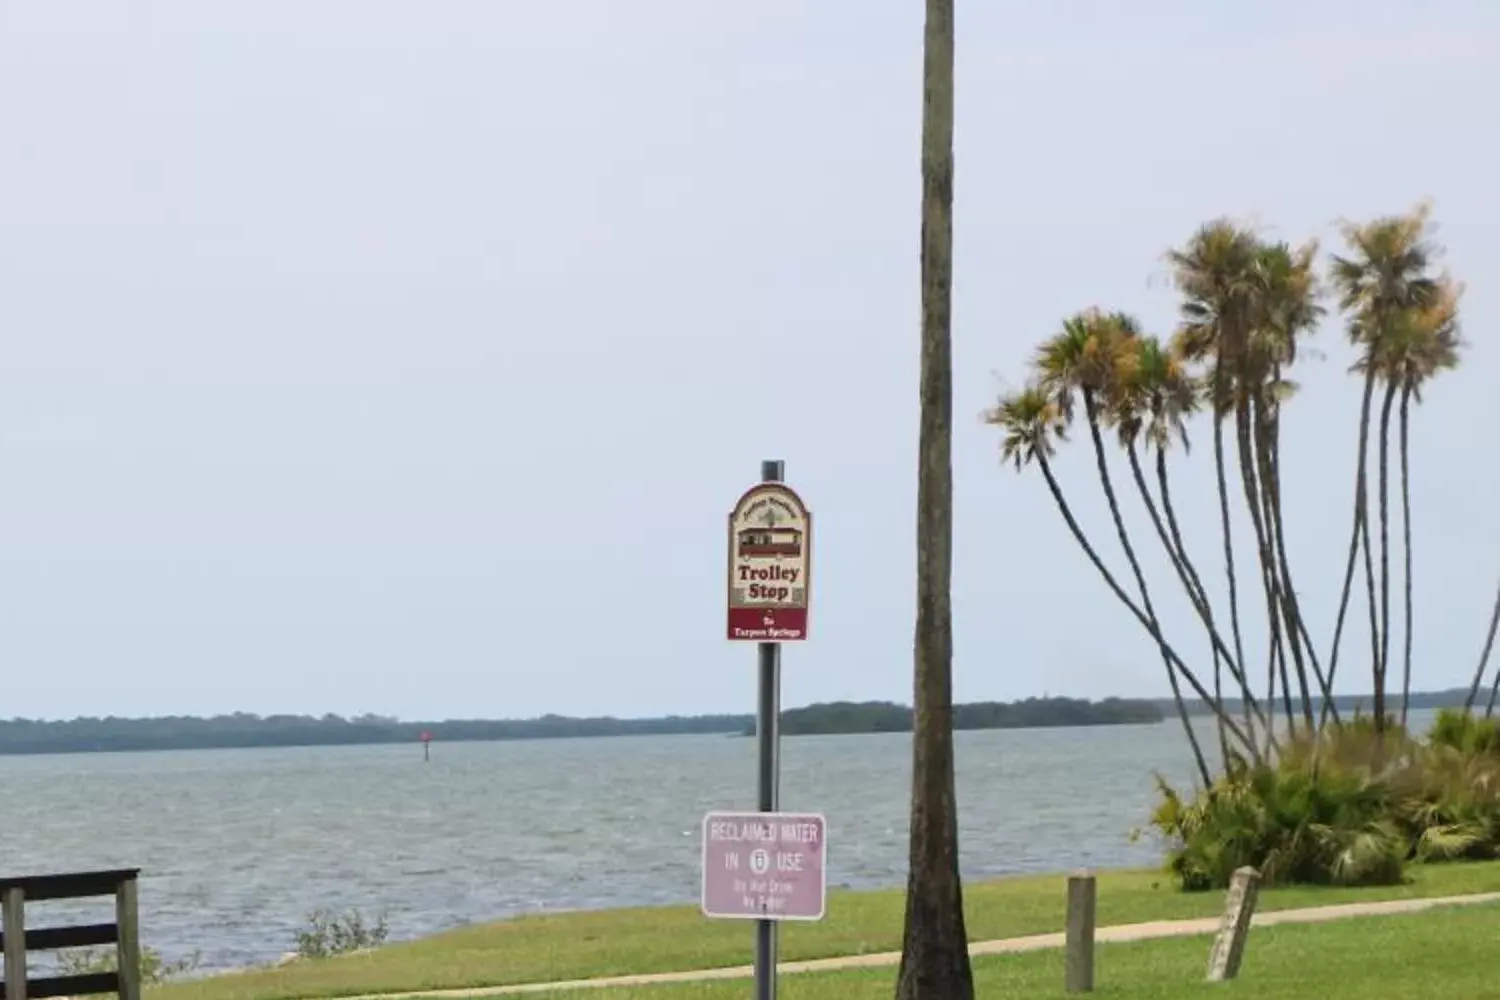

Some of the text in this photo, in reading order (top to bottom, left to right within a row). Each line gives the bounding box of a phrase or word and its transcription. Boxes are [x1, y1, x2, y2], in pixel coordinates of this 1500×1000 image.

[738, 564, 800, 583] Trolley
[748, 583, 788, 601] Stop
[734, 627, 766, 639] Tarpon
[711, 822, 819, 842] RECLAIMED WATER
[725, 852, 804, 871] IN USE
